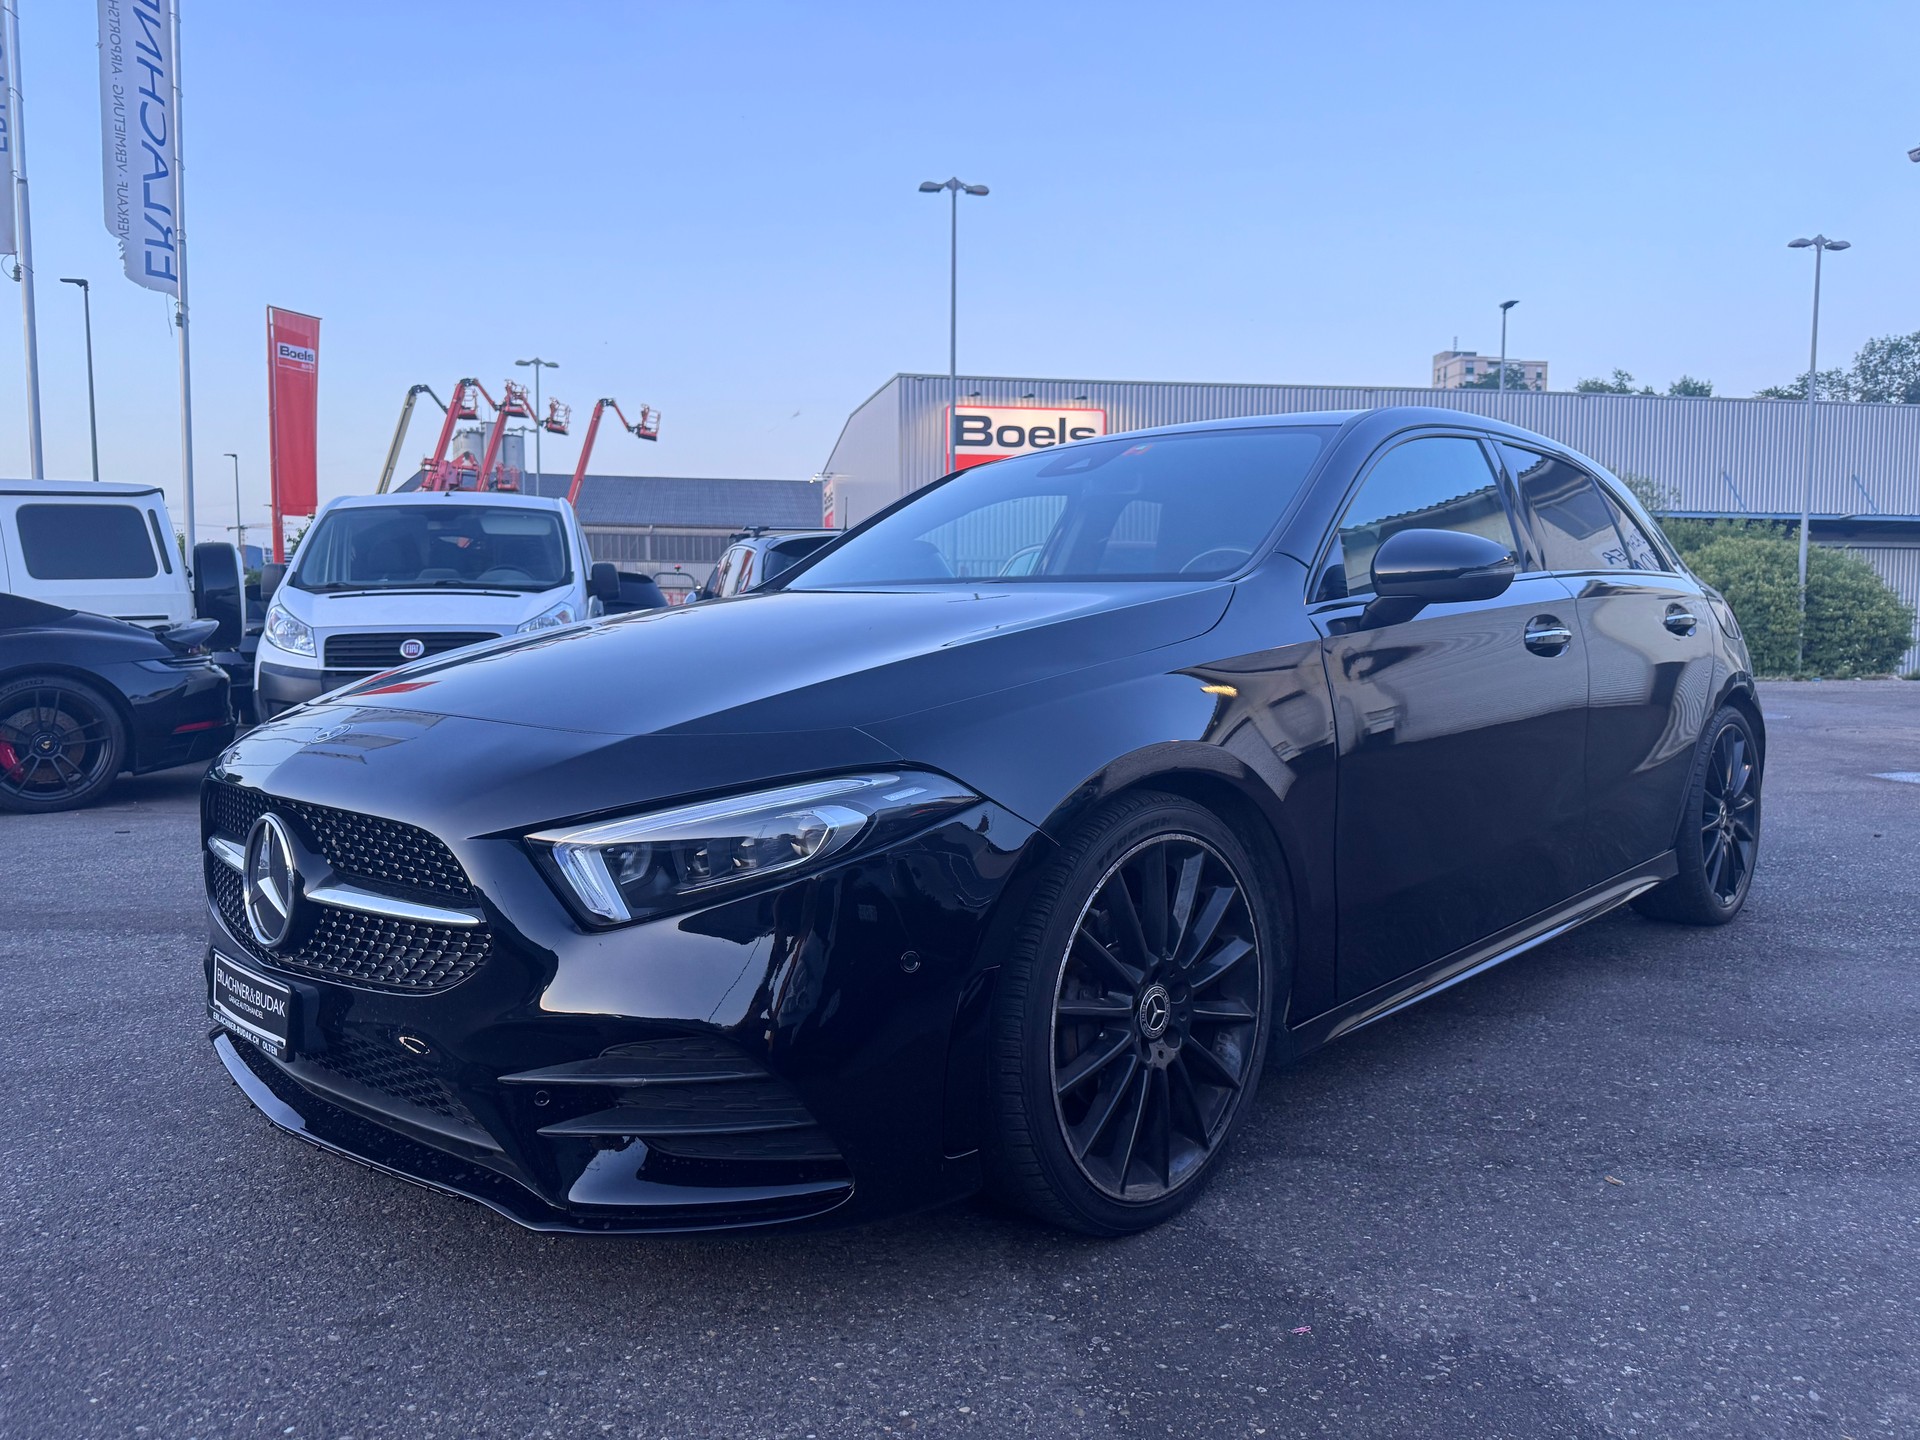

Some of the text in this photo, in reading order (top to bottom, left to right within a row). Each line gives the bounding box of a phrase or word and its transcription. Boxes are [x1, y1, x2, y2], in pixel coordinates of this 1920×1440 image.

[280, 345, 314, 362] Boels
[955, 414, 1096, 448] Boels
[406, 643, 419, 654] FIAT
[262, 1041, 278, 1056] OLTEN
